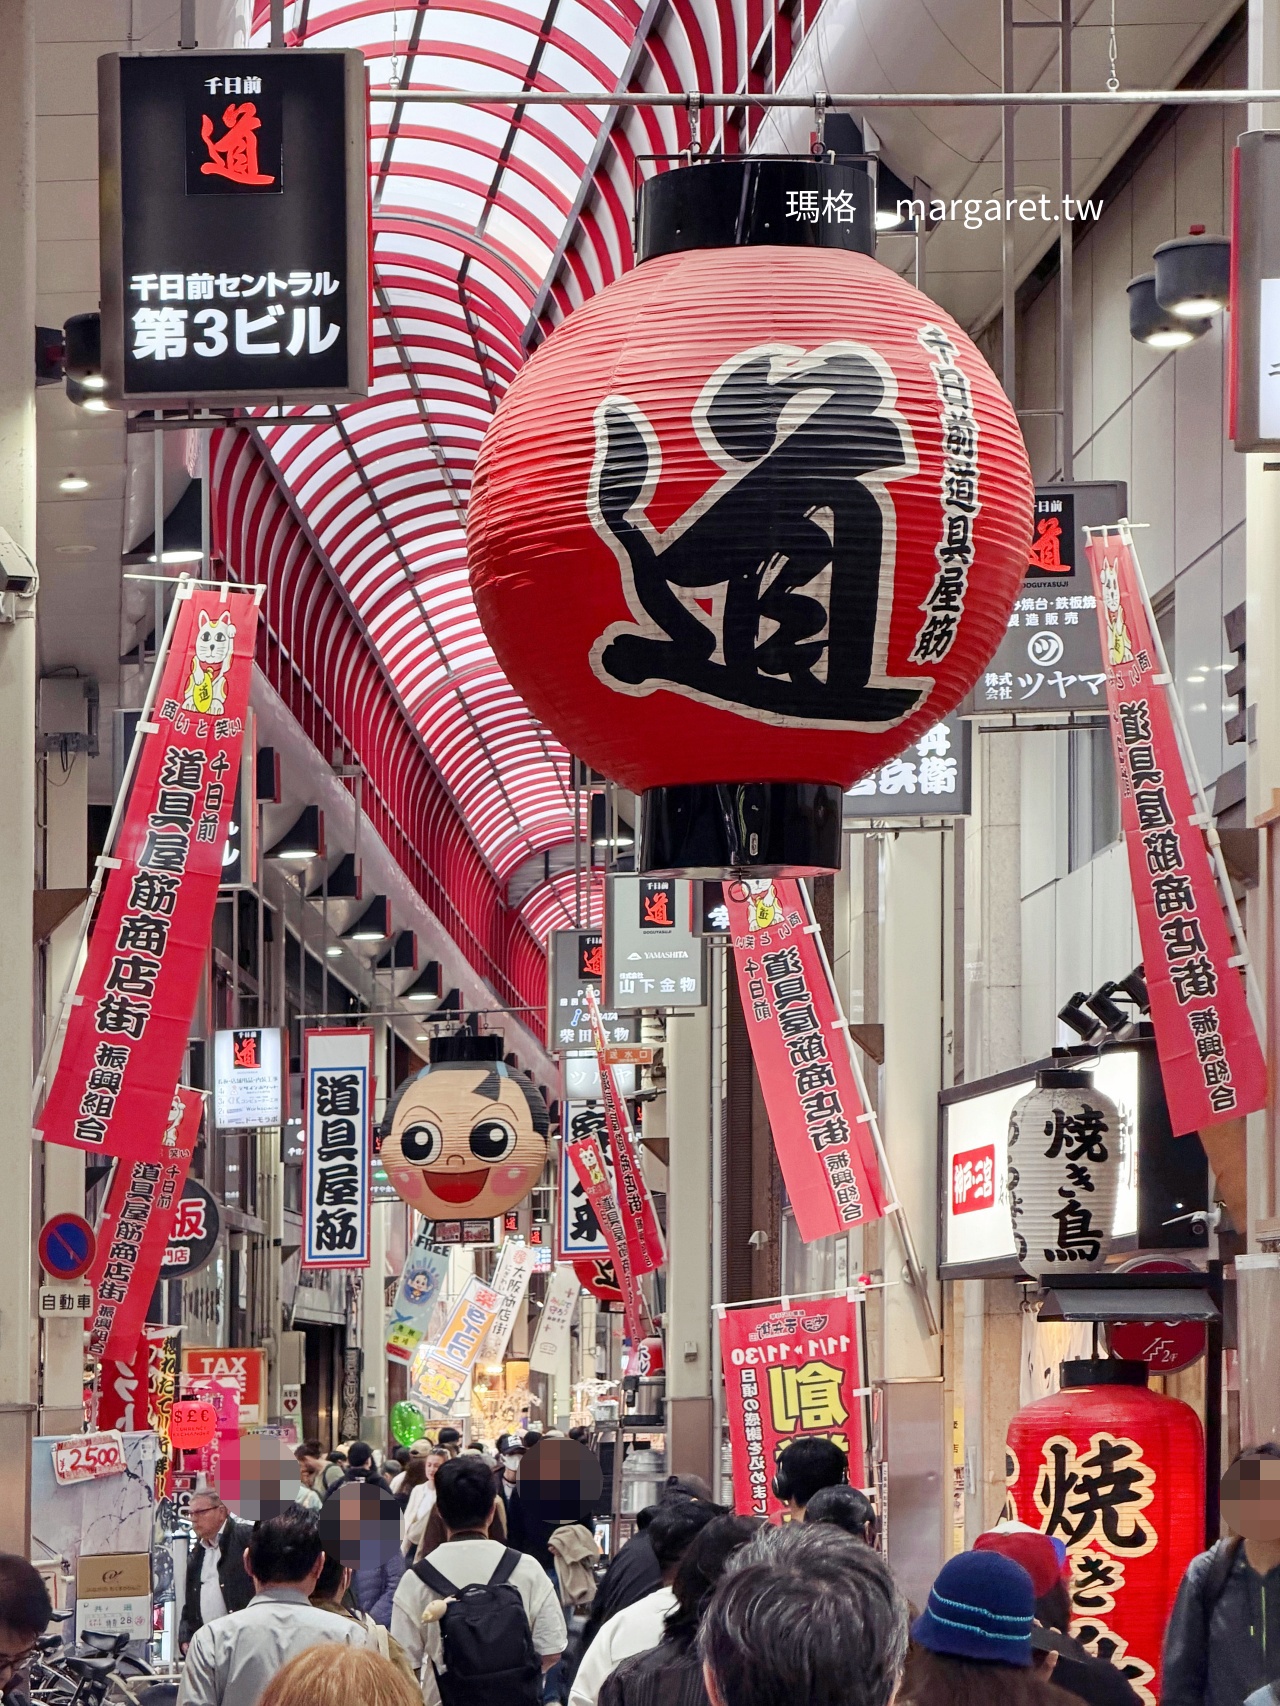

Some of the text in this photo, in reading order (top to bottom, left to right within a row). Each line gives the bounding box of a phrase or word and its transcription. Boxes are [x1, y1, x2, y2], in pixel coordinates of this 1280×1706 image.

[204, 77, 262, 95] 千日前
[200, 102, 275, 185] 道
[130, 271, 340, 300] 千日前セントラル
[131, 306, 341, 360] 第3ビル
[914, 326, 979, 660] 千日前道具屋筋
[1034, 500, 1063, 512] 日前
[596, 345, 930, 724] 道
[1029, 517, 1071, 572] 道
[1007, 612, 1079, 627] 製造販売
[1017, 671, 1107, 700] ツヤマ
[161, 698, 243, 739] 商いと笑い
[197, 752, 230, 843] 千日前
[644, 892, 673, 925] 道
[73, 746, 206, 1144] 道具屋筋商店街 振興組合
[644, 951, 689, 960] YAMASHITA
[619, 977, 696, 994] 山下金物
[316, 1076, 360, 1250] 道具屋筋
[156, 1165, 180, 1210] 千日前
[1043, 1104, 1109, 1263] 焼き鳥
[97, 1161, 162, 1304] 道具屋筋商店街
[415, 1235, 450, 1257] FREE
[43, 1294, 91, 1310] 自動車
[201, 1357, 247, 1374] TAX
[121, 1616, 132, 1625] 28
